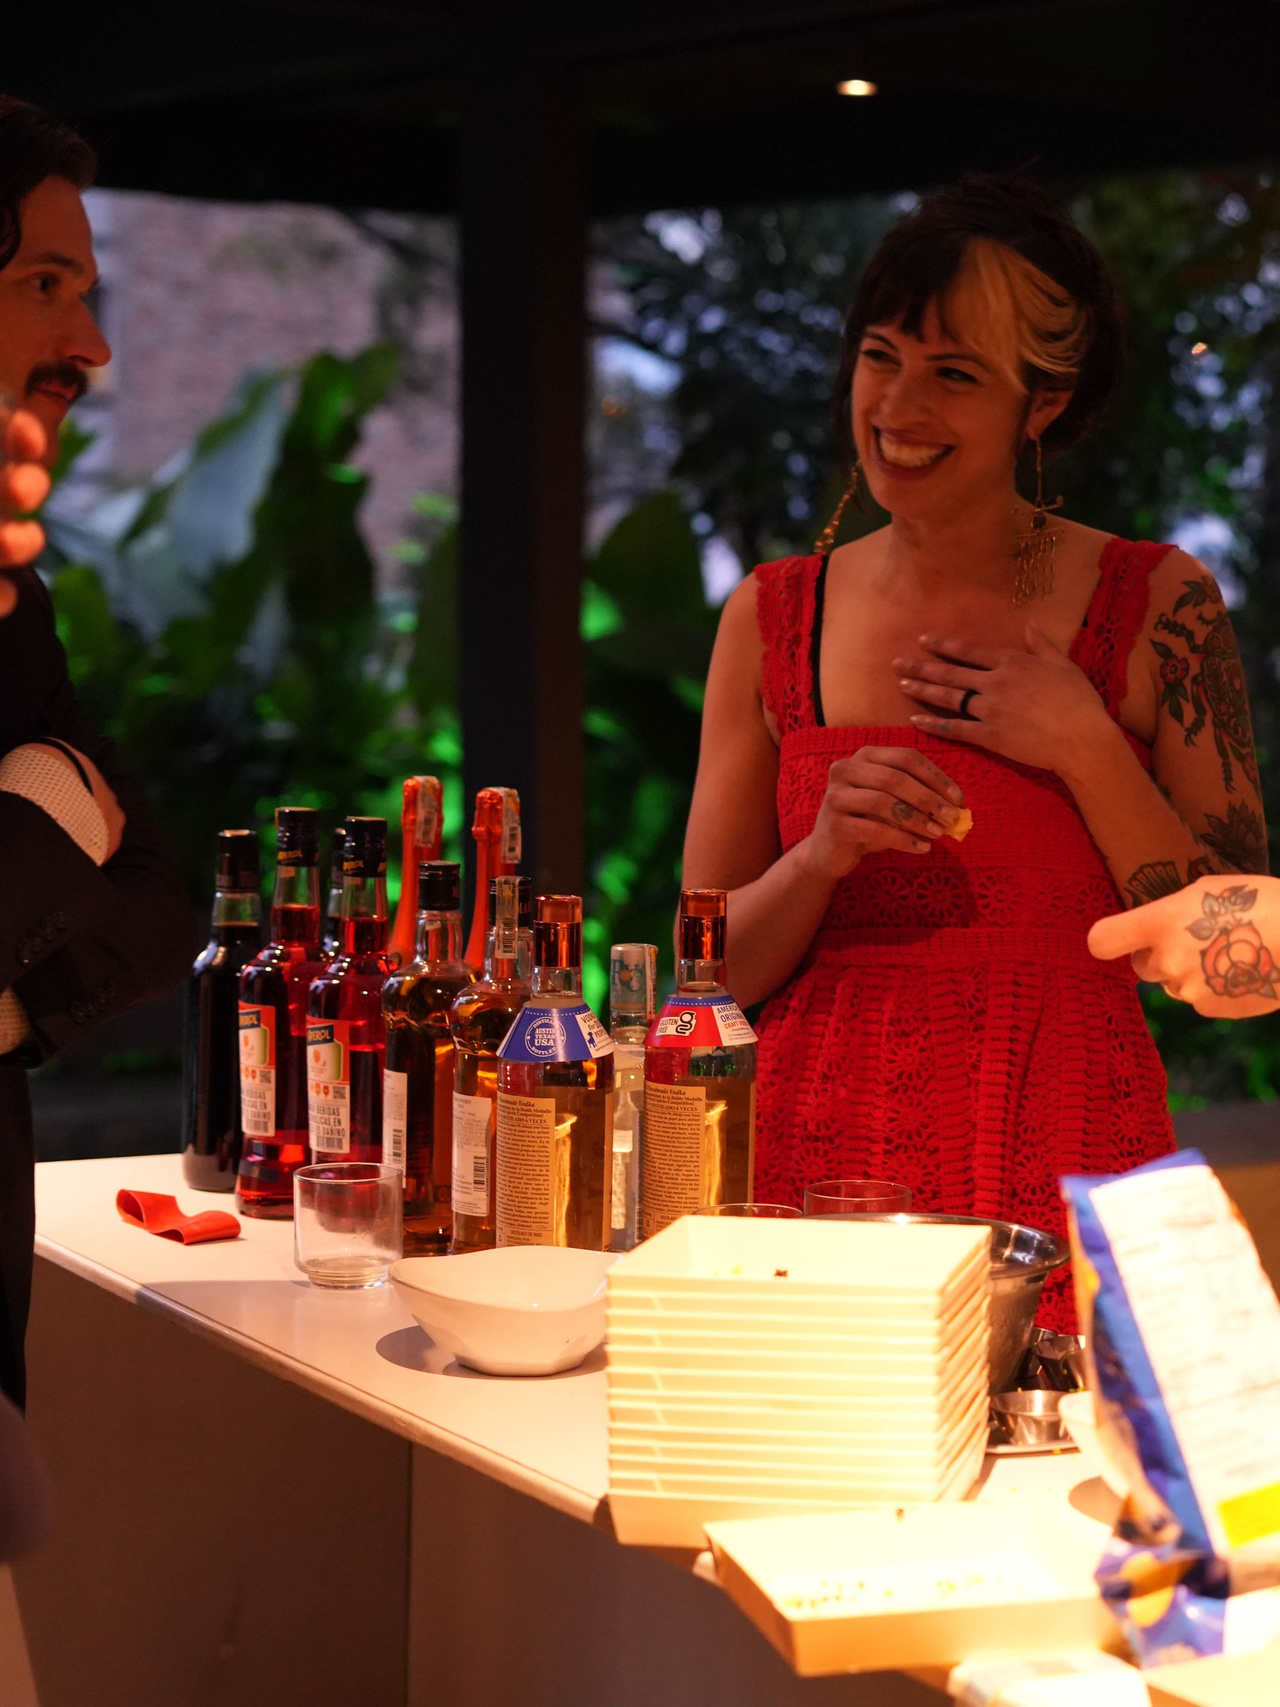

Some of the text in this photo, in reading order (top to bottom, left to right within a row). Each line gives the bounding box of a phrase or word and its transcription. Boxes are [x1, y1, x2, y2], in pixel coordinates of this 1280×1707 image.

[717, 1004, 738, 1014] AMERIC
[660, 1019, 678, 1027] GLUTEN
[534, 1039, 555, 1047] USA
[531, 1046, 557, 1055] BOTTLED
[333, 1117, 342, 1127] EN
